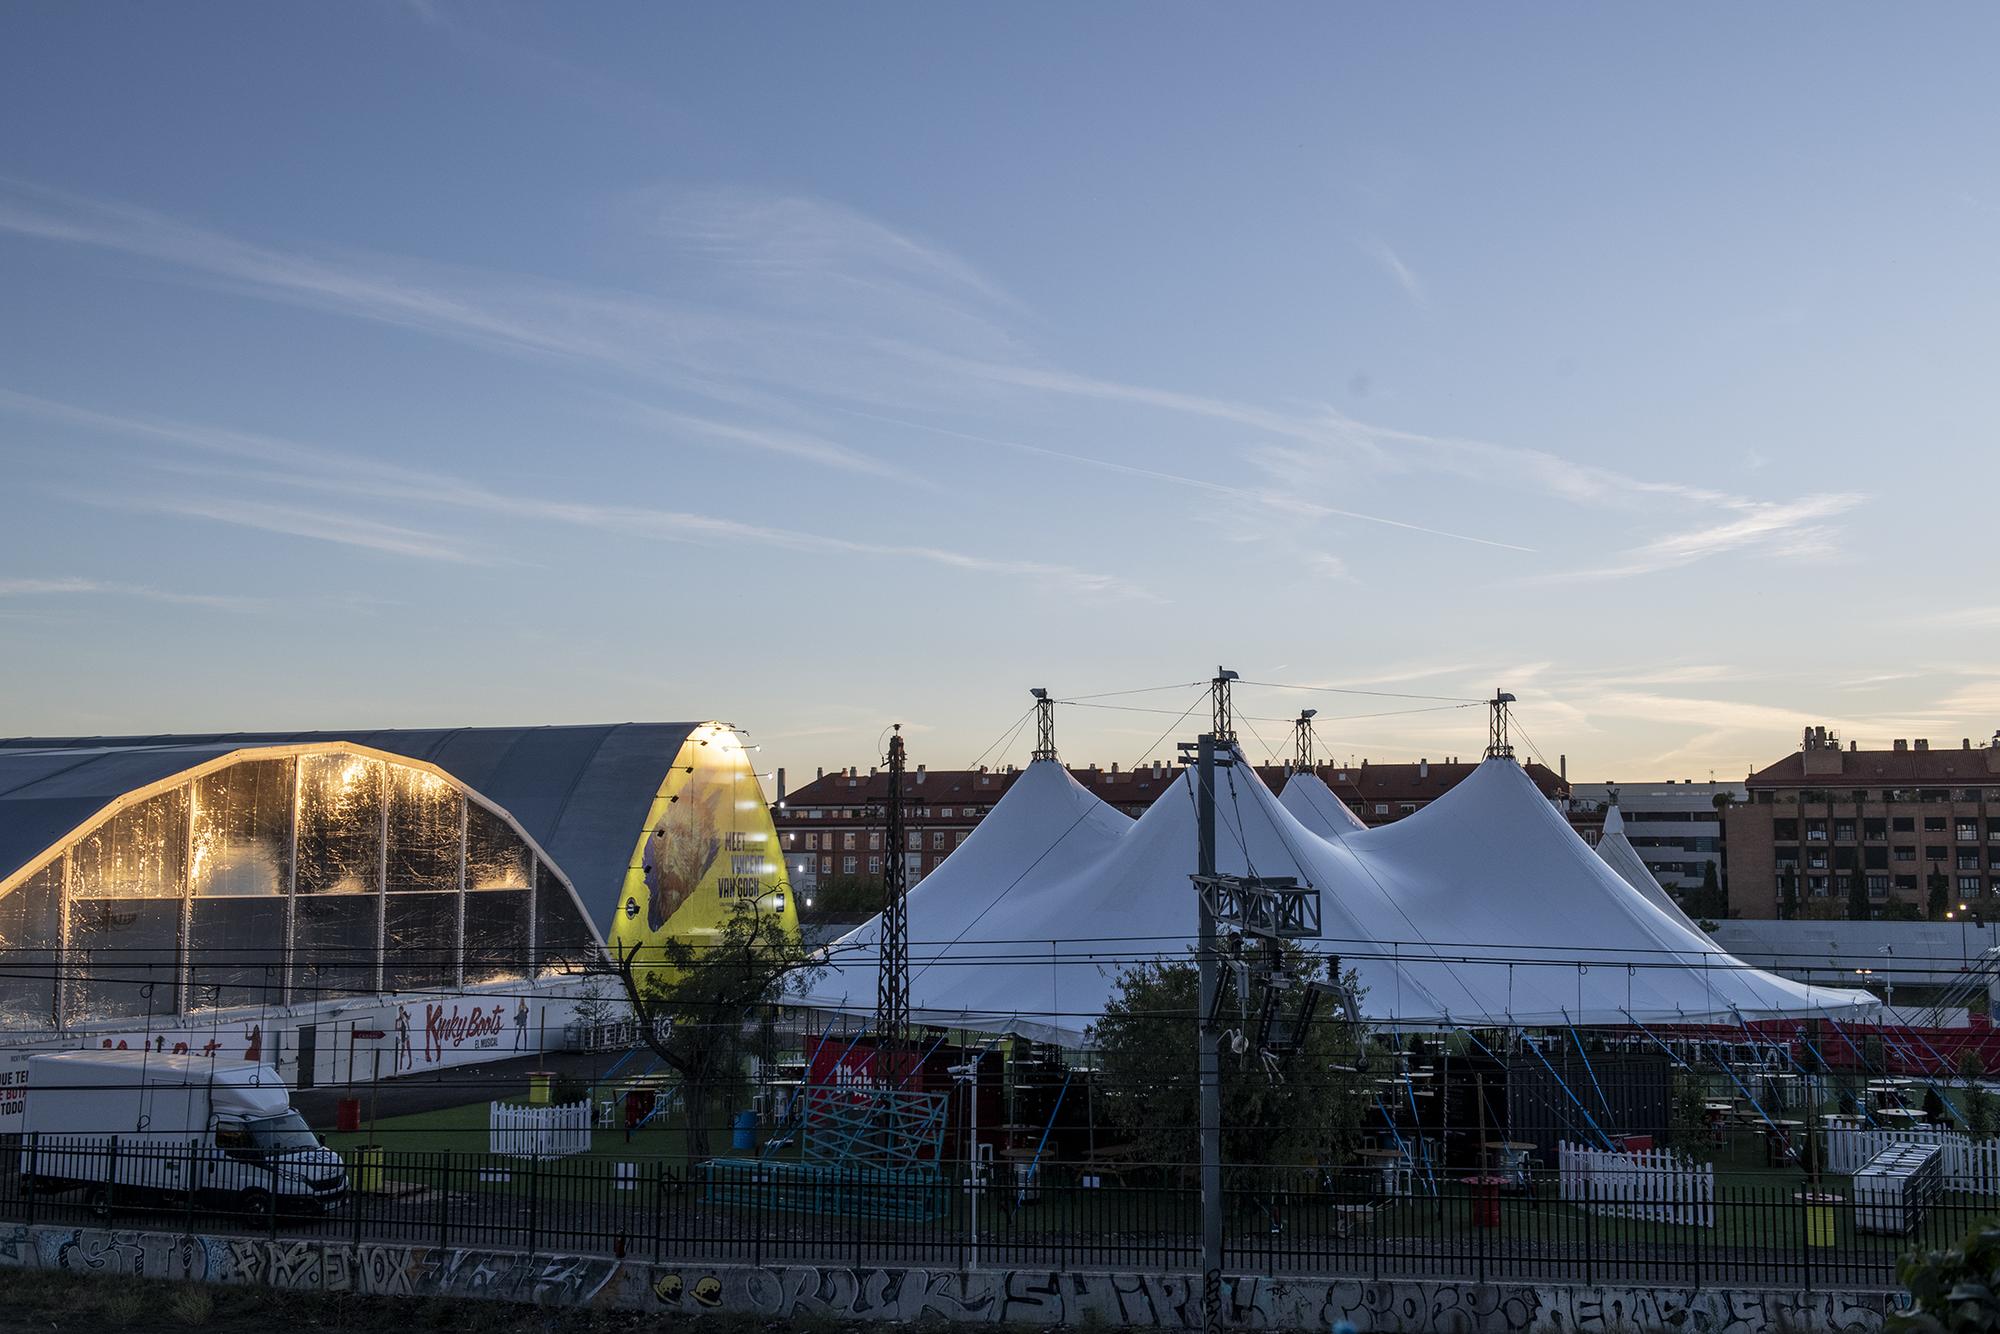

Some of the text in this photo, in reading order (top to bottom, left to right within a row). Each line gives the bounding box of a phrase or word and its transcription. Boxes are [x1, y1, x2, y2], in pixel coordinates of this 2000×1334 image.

[725, 831, 746, 851] MEET
[731, 855, 765, 874] VINCENT
[718, 877, 760, 898] VAN GOGH
[425, 1003, 505, 1062] Kinky Boots
[0, 1071, 12, 1086] UE
[1, 1101, 23, 1116] TODO
